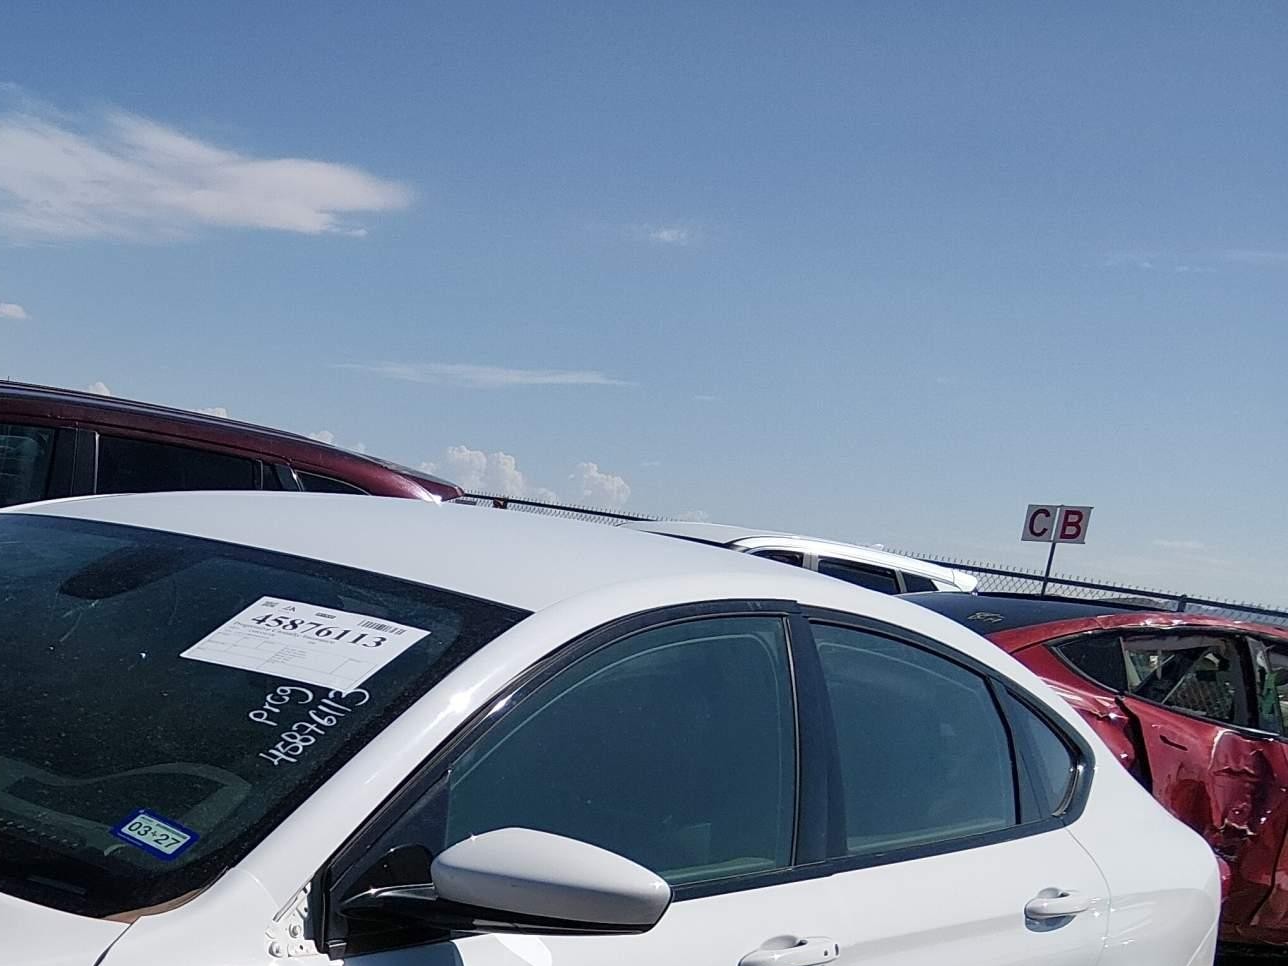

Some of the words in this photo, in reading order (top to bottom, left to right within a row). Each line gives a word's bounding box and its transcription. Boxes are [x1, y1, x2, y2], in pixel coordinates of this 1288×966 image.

[1028, 508, 1051, 537] C
[1059, 509, 1083, 540] B
[251, 613, 387, 648] 45876113
[258, 687, 370, 767] 45876113
